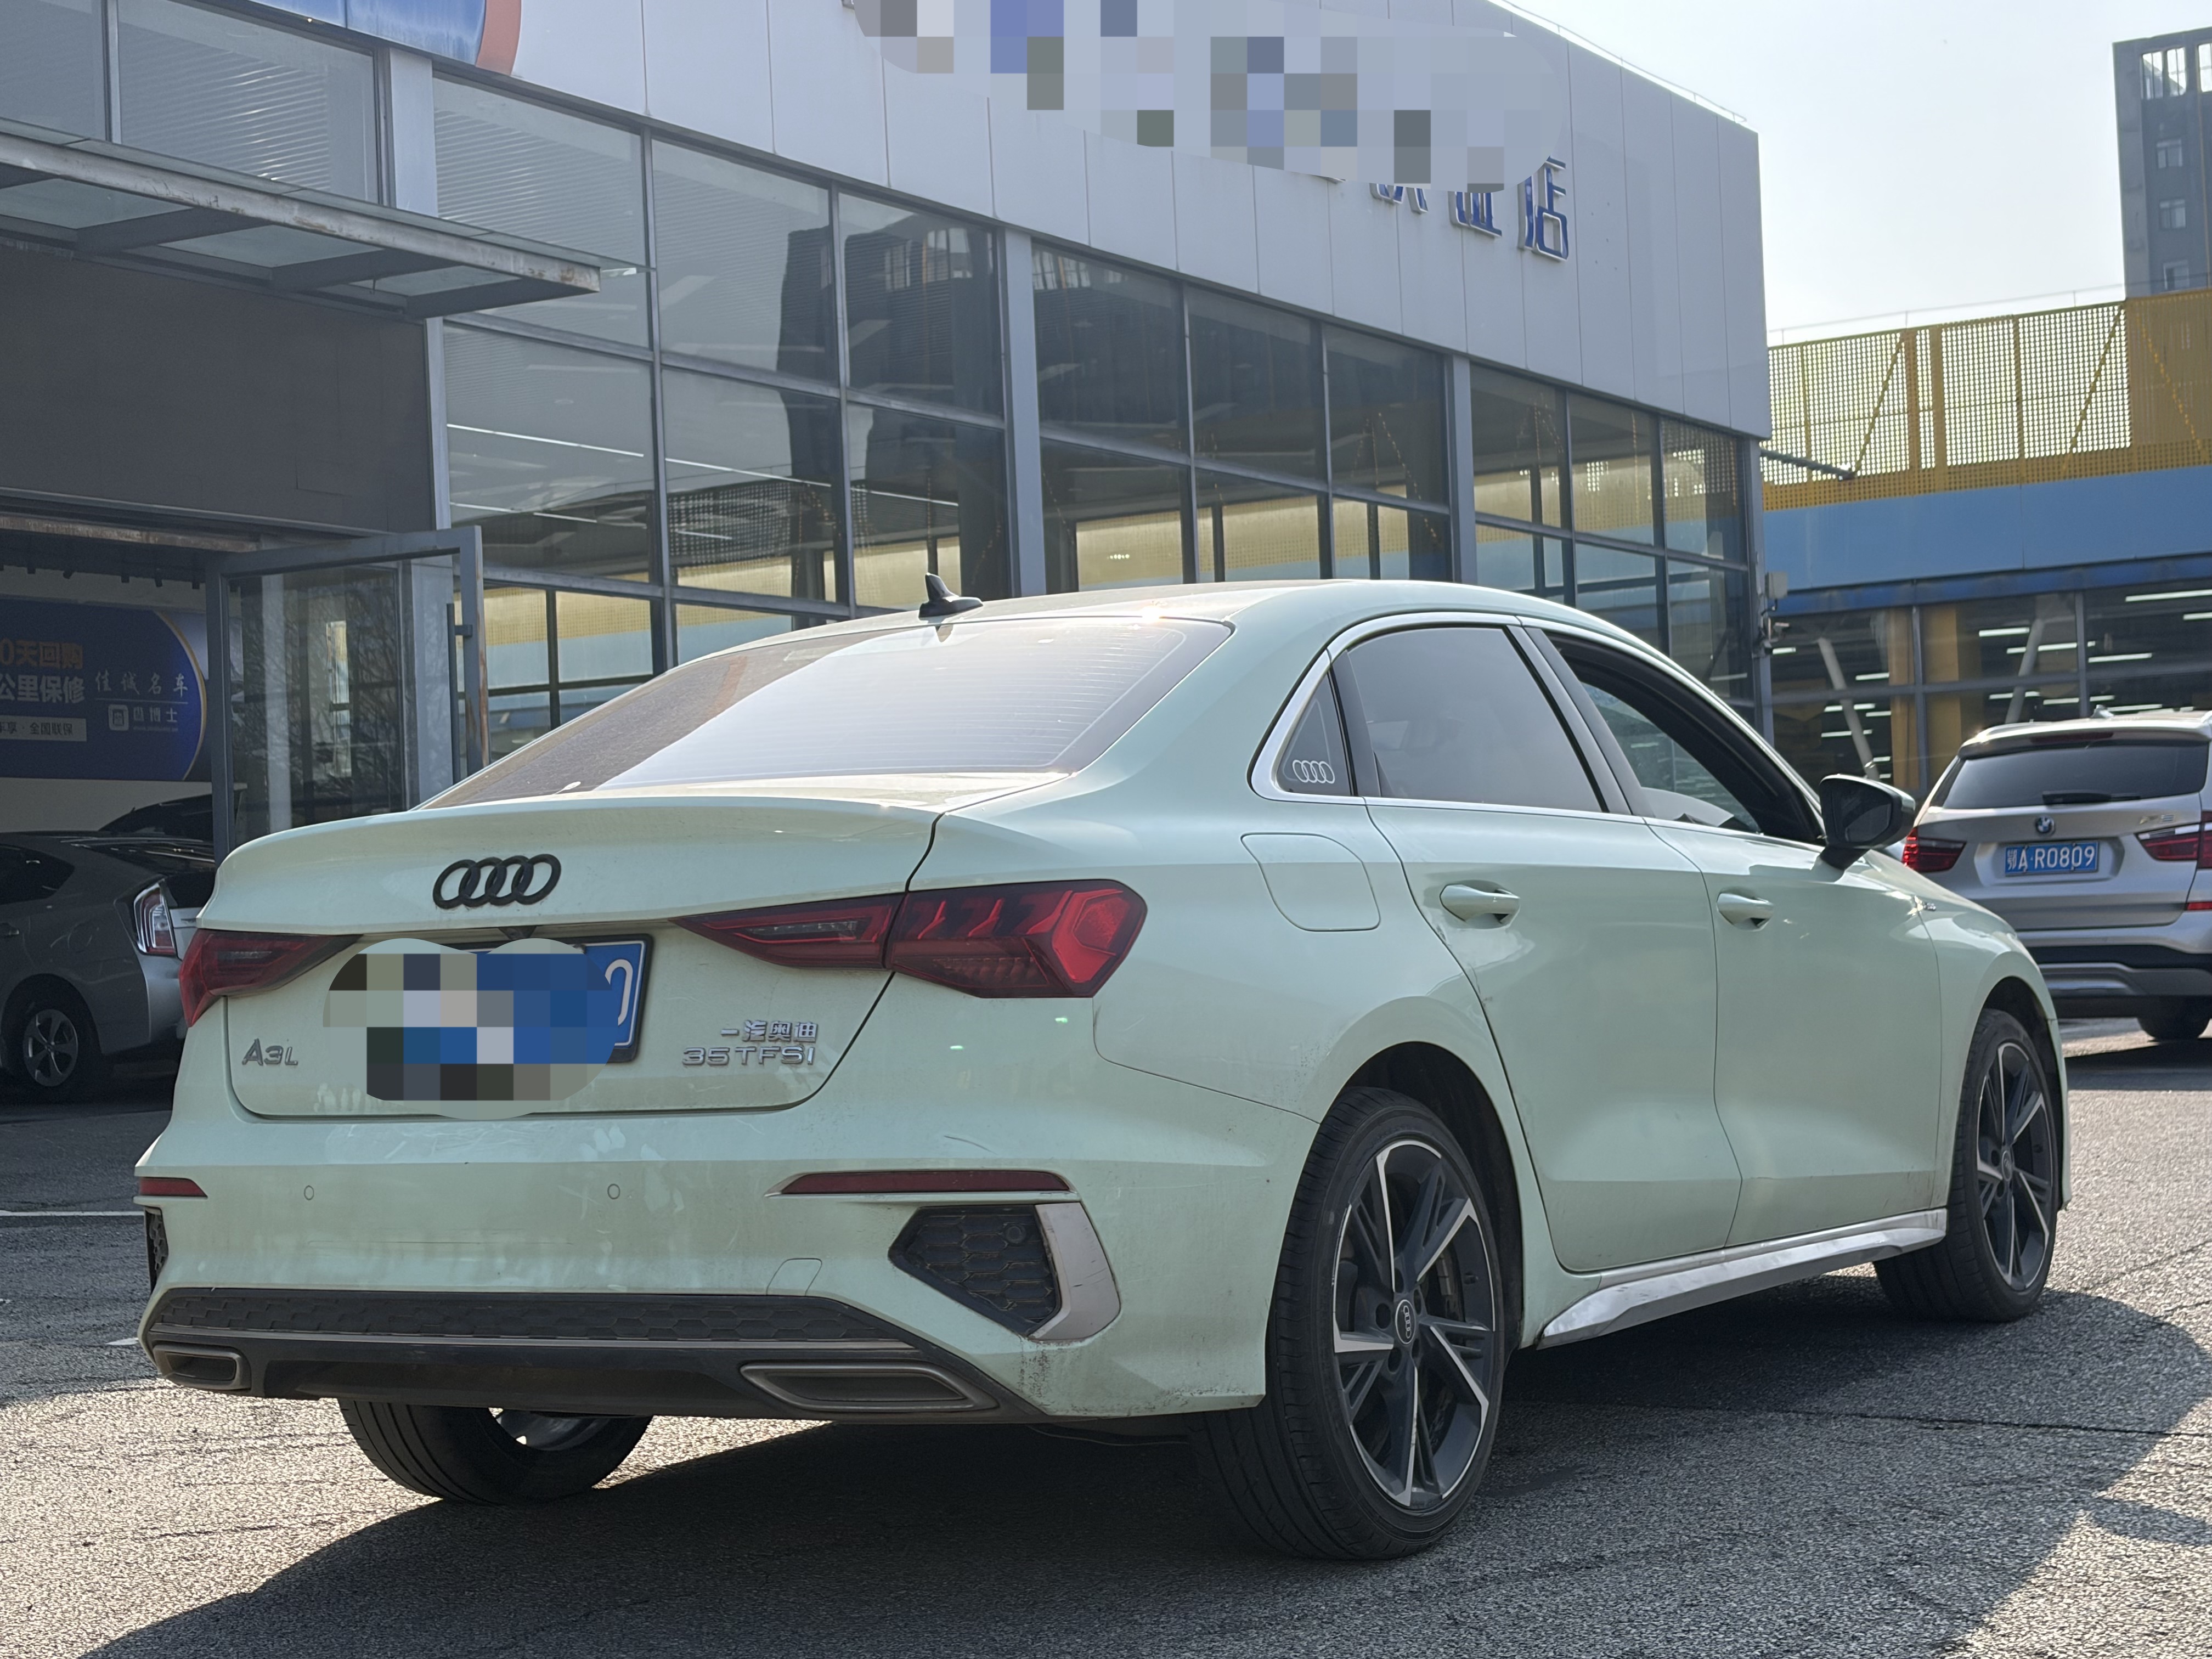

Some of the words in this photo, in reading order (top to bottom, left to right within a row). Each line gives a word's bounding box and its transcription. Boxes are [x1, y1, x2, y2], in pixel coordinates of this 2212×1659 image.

[0, 673, 85, 704] 公里保修
[720, 1019, 818, 1043] 一汽奥迪
[241, 1038, 298, 1066] A3L
